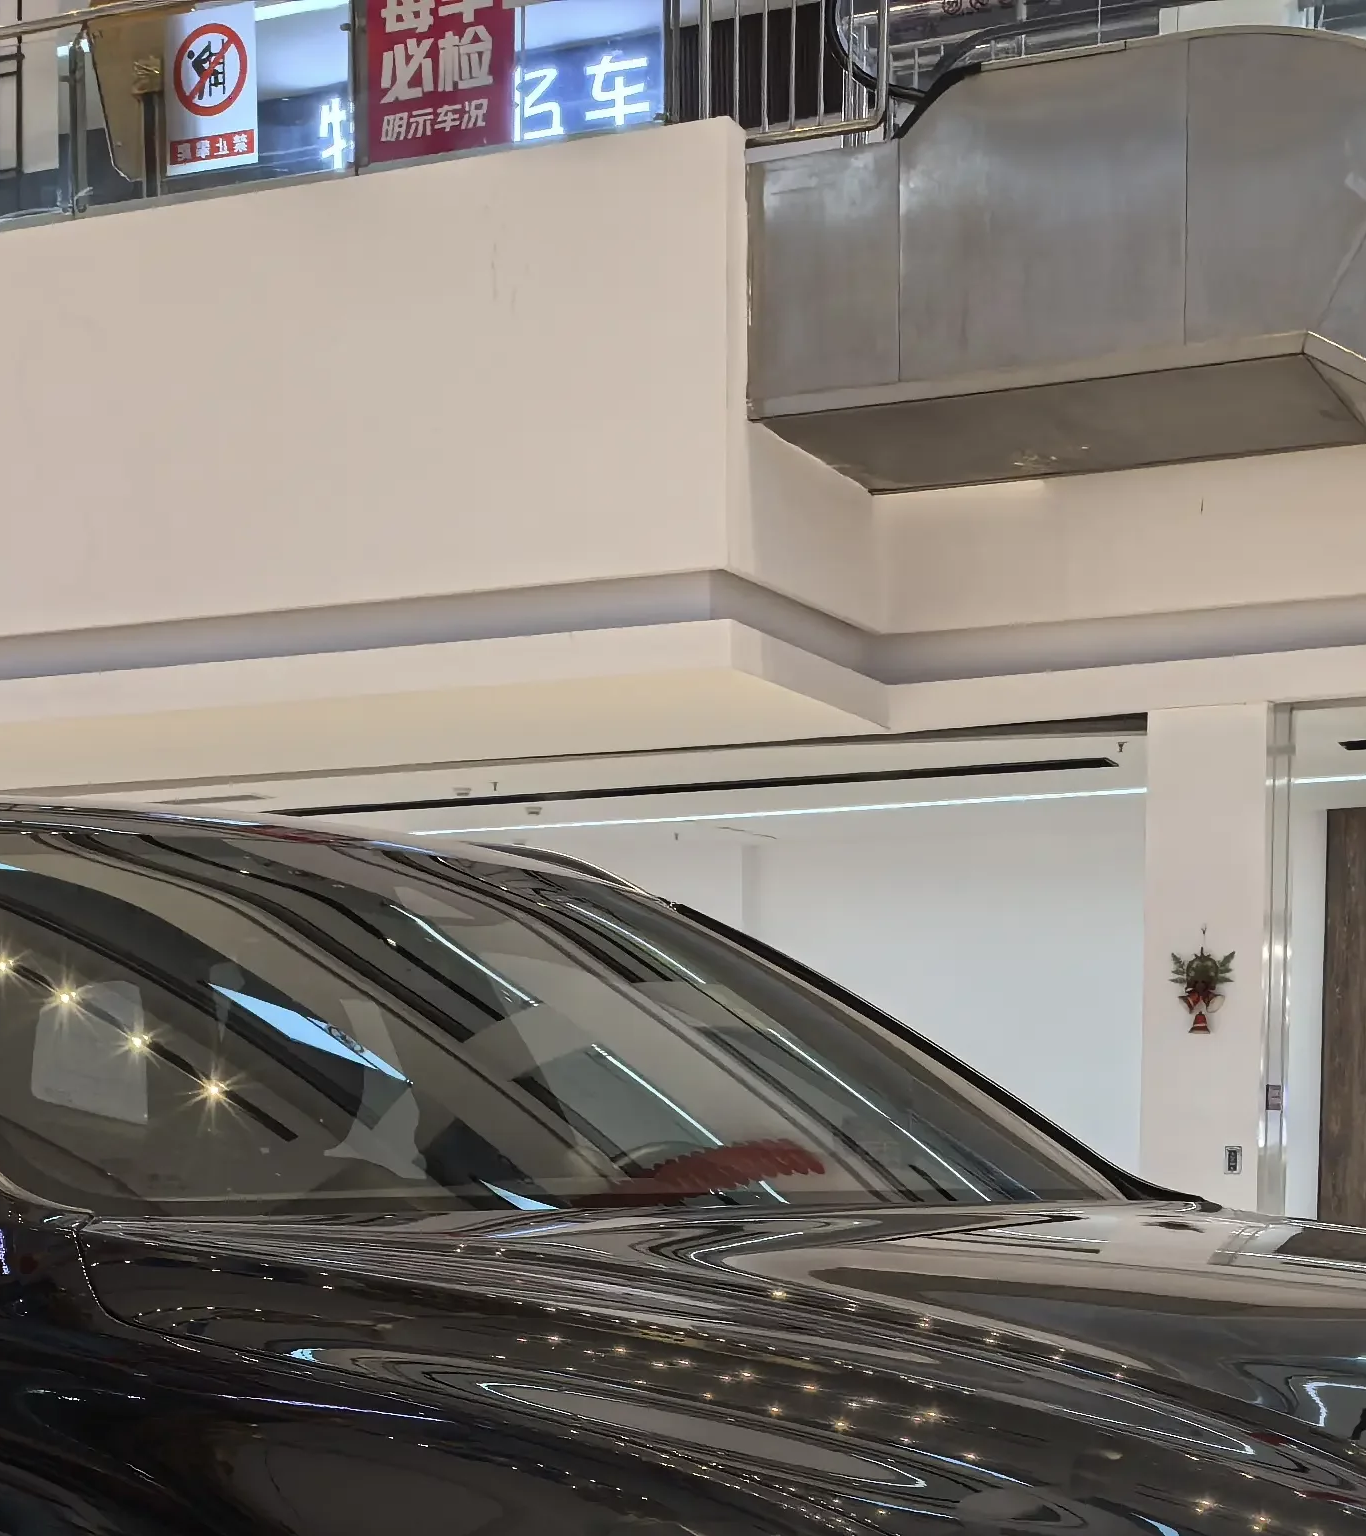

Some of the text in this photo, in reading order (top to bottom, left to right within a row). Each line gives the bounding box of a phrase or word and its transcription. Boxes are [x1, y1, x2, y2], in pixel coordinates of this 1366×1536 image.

[380, 26, 493, 104] 必检
[381, 99, 488, 141] 明示车况
